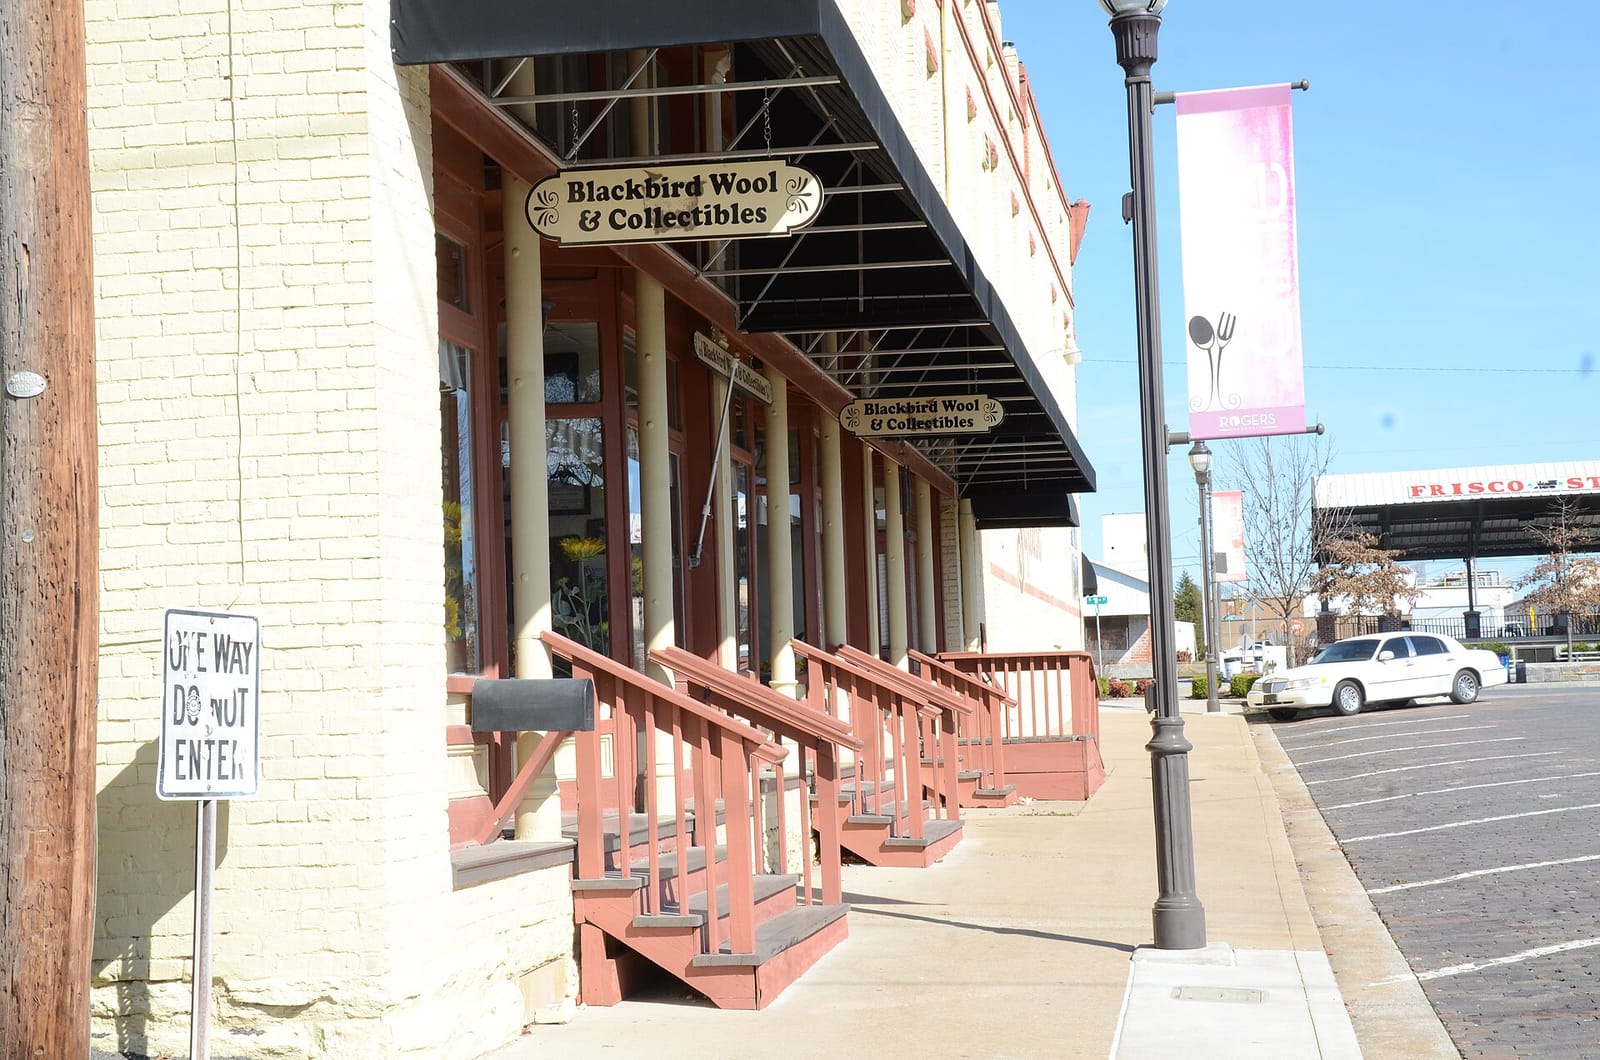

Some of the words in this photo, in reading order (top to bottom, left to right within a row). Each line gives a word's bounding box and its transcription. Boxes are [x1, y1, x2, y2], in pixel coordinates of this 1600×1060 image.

[567, 175, 701, 203] Blackbird
[709, 171, 778, 196] Wool
[578, 209, 601, 232] &
[608, 205, 767, 230] Collectibles
[864, 401, 938, 416] Blackbird
[942, 399, 980, 412] Wool
[870, 418, 884, 431] &
[887, 416, 974, 431] Collectibles
[1219, 413, 1277, 428] ROGERS
[1410, 480, 1525, 497] FRISCO
[213, 633, 253, 675] WAY
[173, 684, 202, 726] DO
